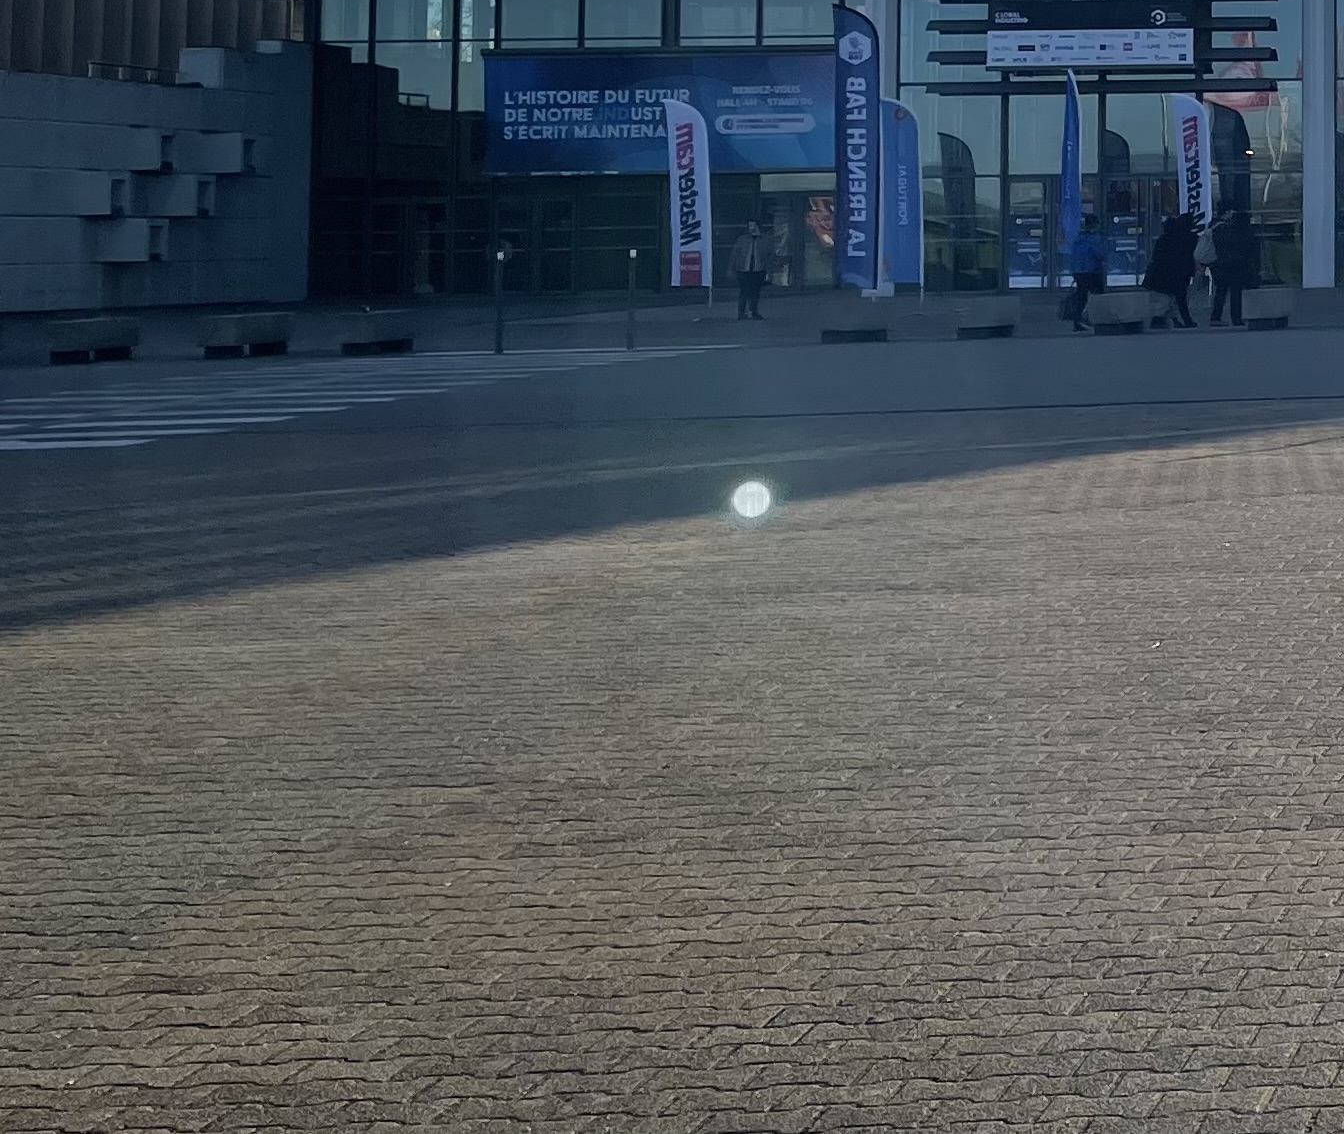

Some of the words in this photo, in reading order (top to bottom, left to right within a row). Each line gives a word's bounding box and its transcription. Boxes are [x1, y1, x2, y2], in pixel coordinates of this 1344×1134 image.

[504, 90, 600, 105] L'HISTOIRE
[604, 89, 630, 104] DU
[504, 108, 529, 123] DE
[532, 107, 594, 122] NOTRE
[573, 124, 668, 139] MAINTENA
